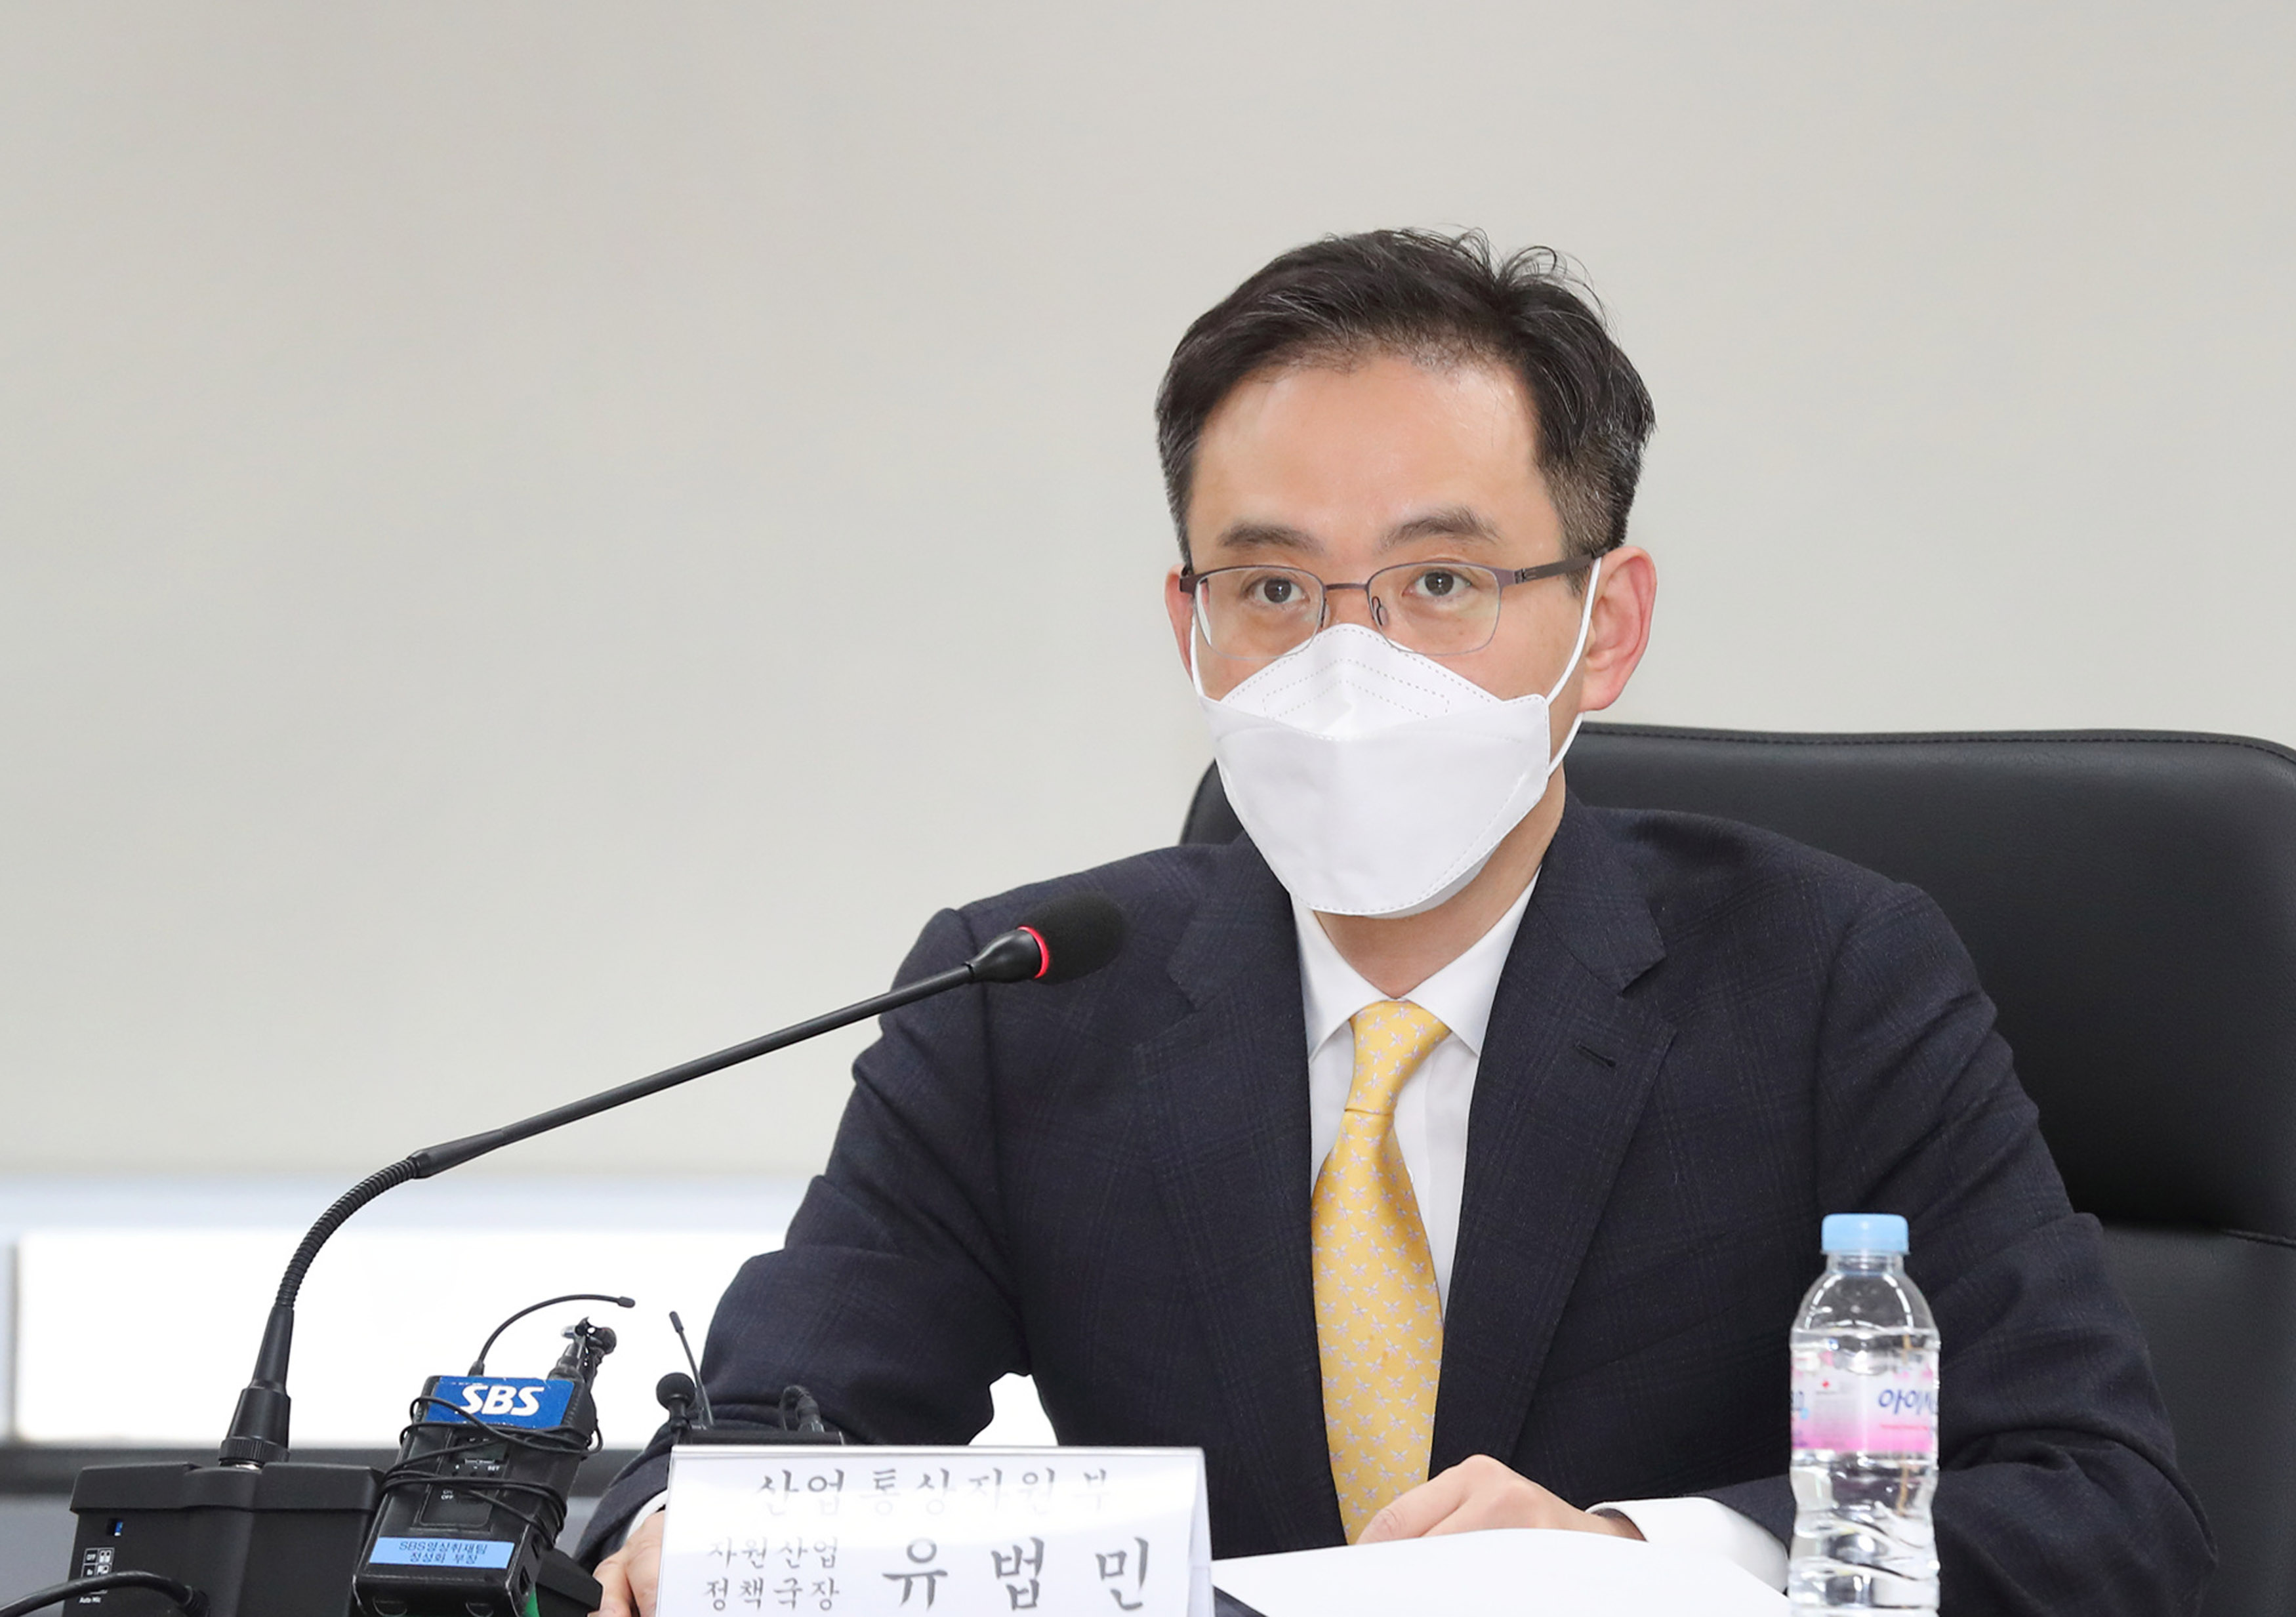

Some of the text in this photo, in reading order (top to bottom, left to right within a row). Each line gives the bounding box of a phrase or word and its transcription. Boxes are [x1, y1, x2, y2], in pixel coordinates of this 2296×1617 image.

[461, 1385, 545, 1417] SBS
[707, 1537, 840, 1568] 자원산업
[705, 1576, 840, 1611] 정책국장
